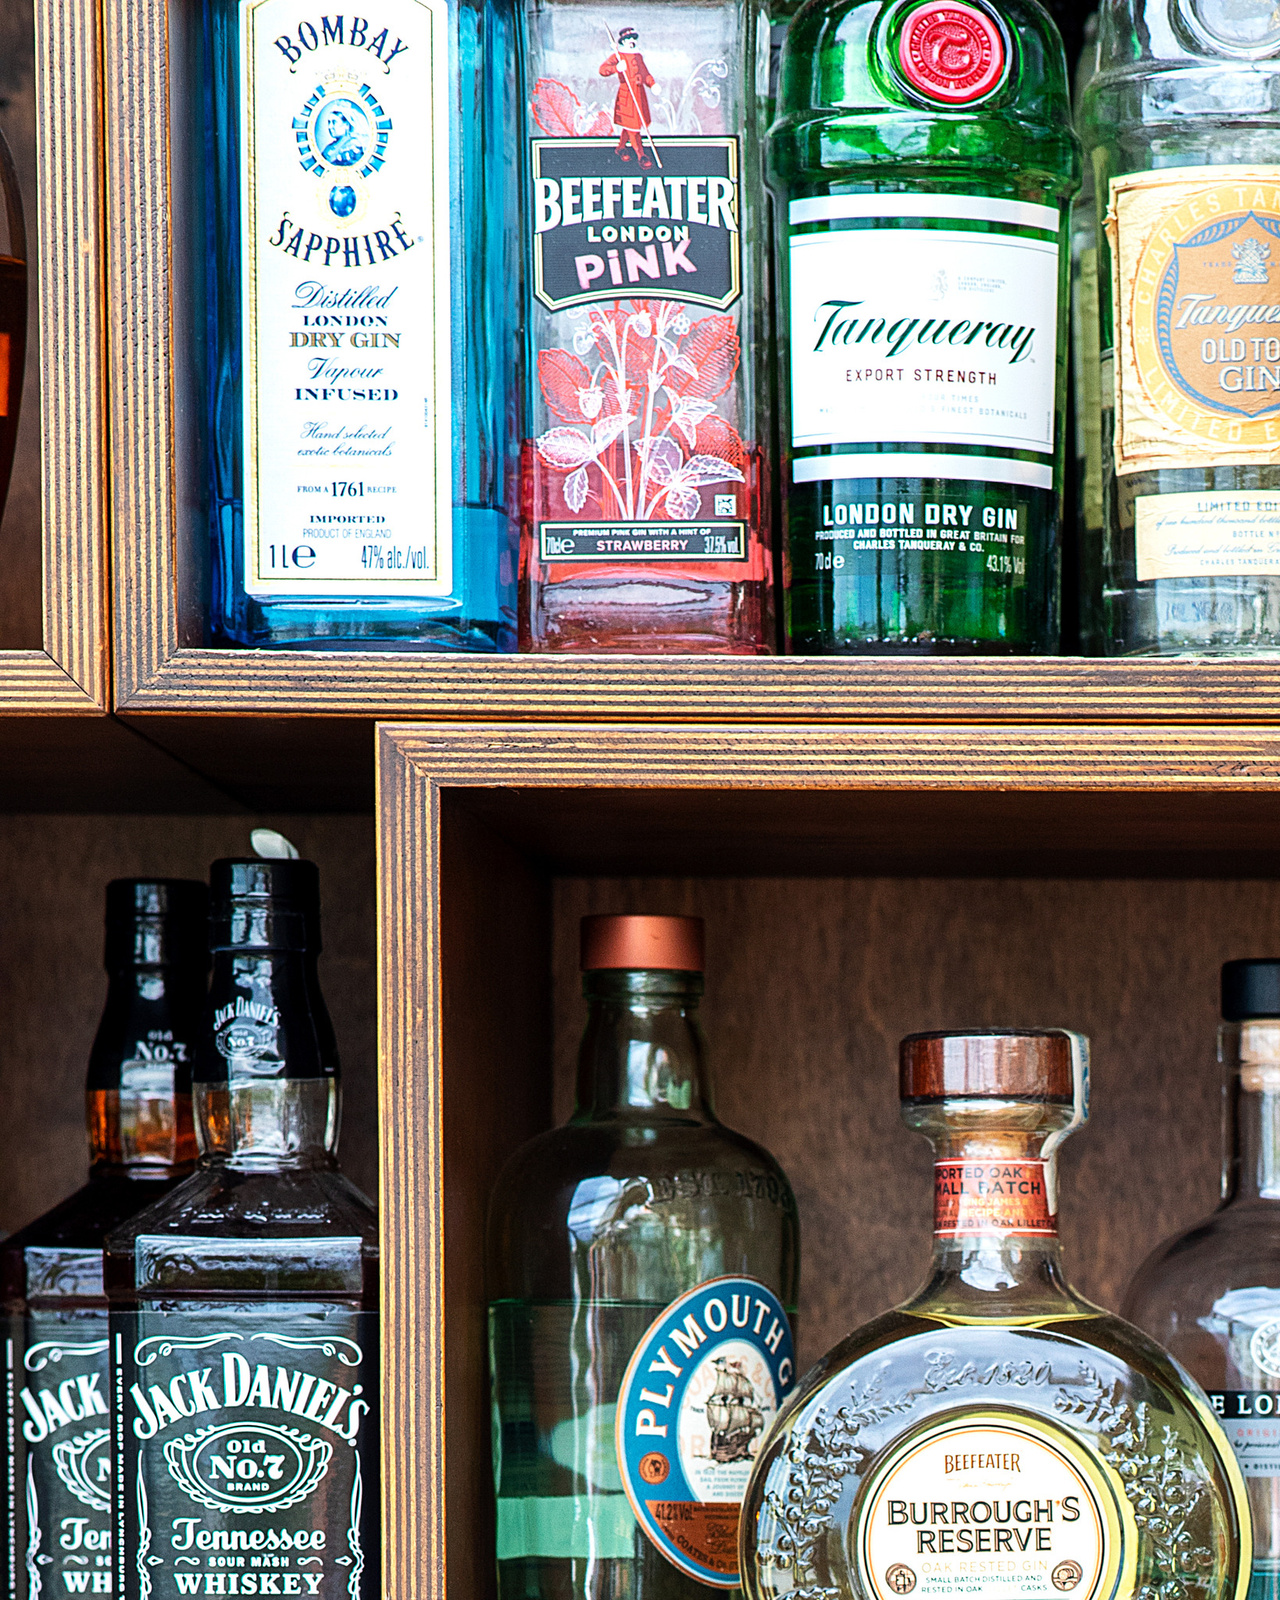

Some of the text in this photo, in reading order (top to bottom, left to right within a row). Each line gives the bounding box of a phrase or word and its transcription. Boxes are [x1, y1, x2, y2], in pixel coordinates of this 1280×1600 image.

[274, 15, 409, 75] BOMBAY
[534, 175, 739, 234] BEEFEATER
[269, 210, 414, 267] SAPPHIRE
[586, 224, 690, 244] LONDON
[1136, 192, 1222, 306] CHARLES
[292, 280, 396, 309] Distilled
[304, 315, 388, 326] LONDON
[813, 299, 1036, 365] Tanqueray
[290, 332, 401, 348] DRY GIN
[1202, 337, 1245, 364] OLD
[307, 357, 384, 384] Vapour
[846, 368, 998, 386] EXPORT STRENGTH
[295, 388, 399, 401] INFUSED
[1143, 364, 1243, 441] LIMITED
[300, 420, 390, 441] Hand selected
[297, 443, 393, 458] exotic botanicals
[309, 514, 386, 523] IMPORTED
[822, 502, 1018, 530] LONDON DRY GIN
[361, 544, 384, 570] 47%
[596, 537, 689, 553] STRAWBERRY
[635, 1293, 785, 1439] PLYMOUTH
[19, 1371, 111, 1443] JACK
[129, 1352, 370, 1441] JACK DANIEL'S
[227, 1439, 266, 1455] Old
[944, 1452, 1022, 1474] BEEFEATER
[227, 1482, 270, 1493] BRAND
[886, 1495, 1081, 1526] BURROUGH'S
[171, 1517, 327, 1551] Tennessee
[916, 1528, 1052, 1554] RESERVE
[208, 1556, 290, 1568] SOUR MASH
[173, 1572, 325, 1597] WHISKEY
